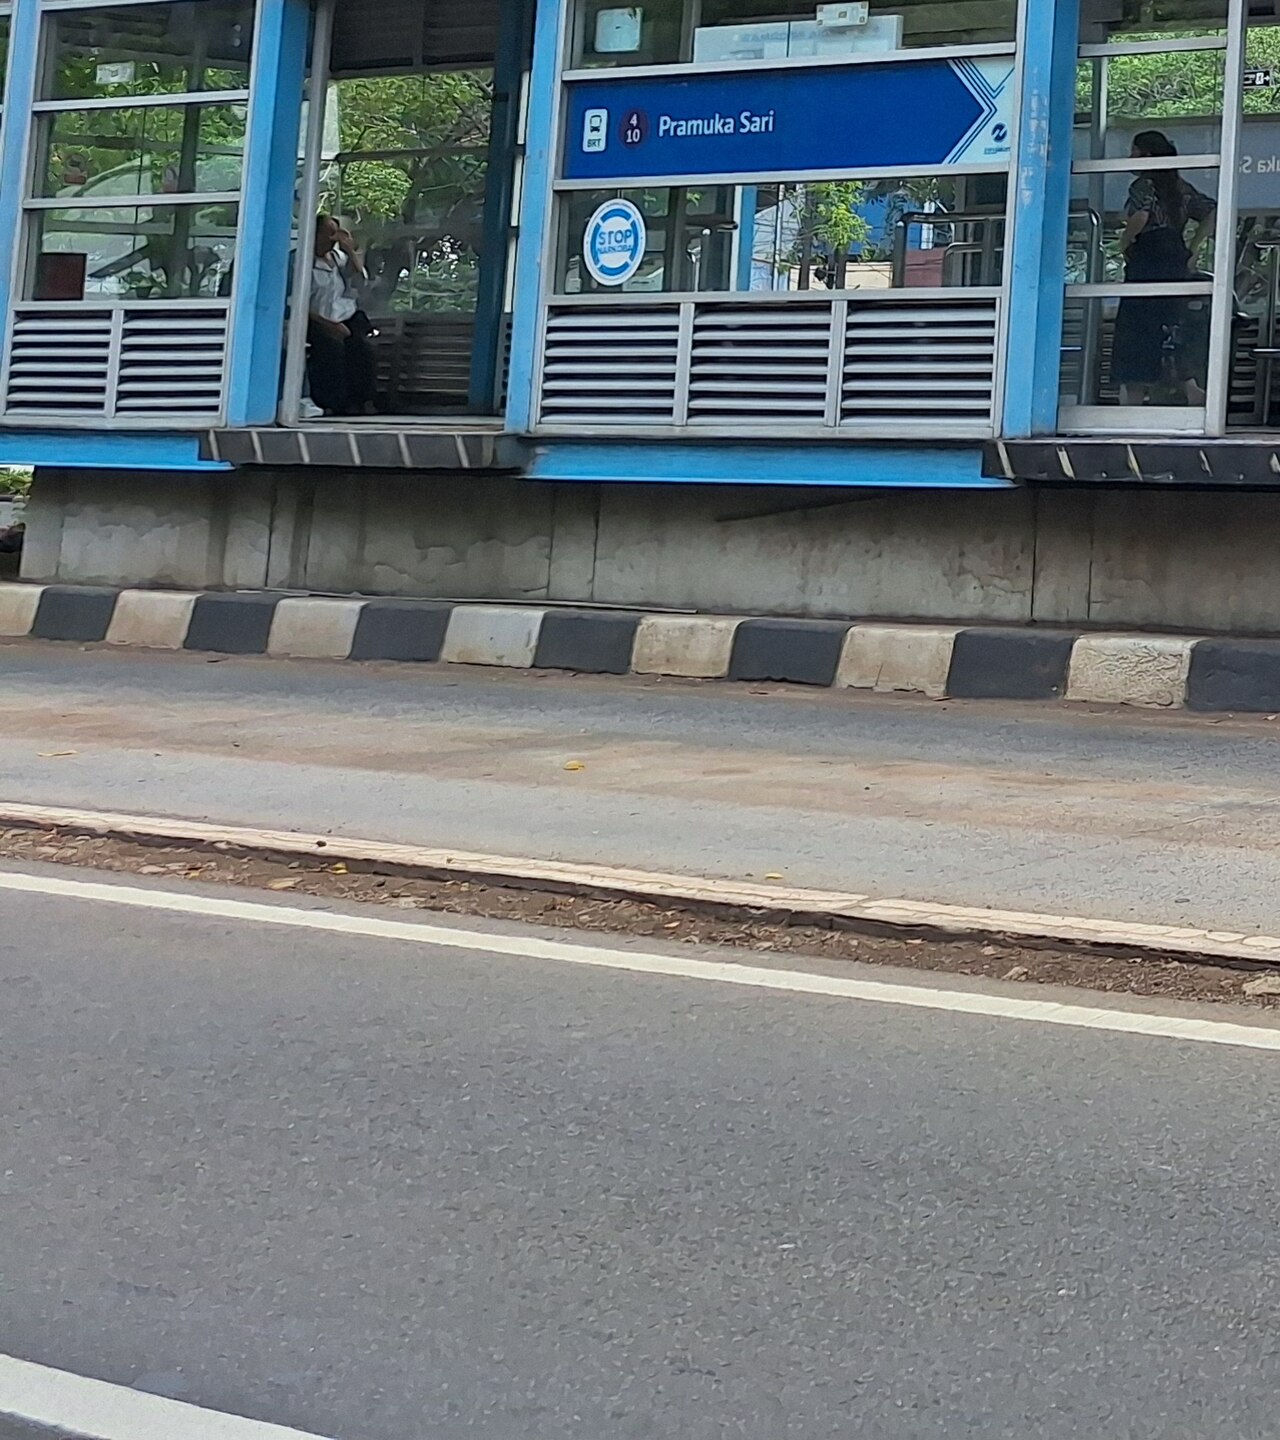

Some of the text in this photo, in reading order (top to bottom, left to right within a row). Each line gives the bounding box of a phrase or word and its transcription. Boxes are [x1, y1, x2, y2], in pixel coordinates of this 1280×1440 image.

[629, 113, 638, 127] 4
[658, 110, 775, 137] Pramuka Sari
[587, 138, 602, 148] BRT
[626, 128, 641, 143] 10
[598, 229, 632, 246] STOP
